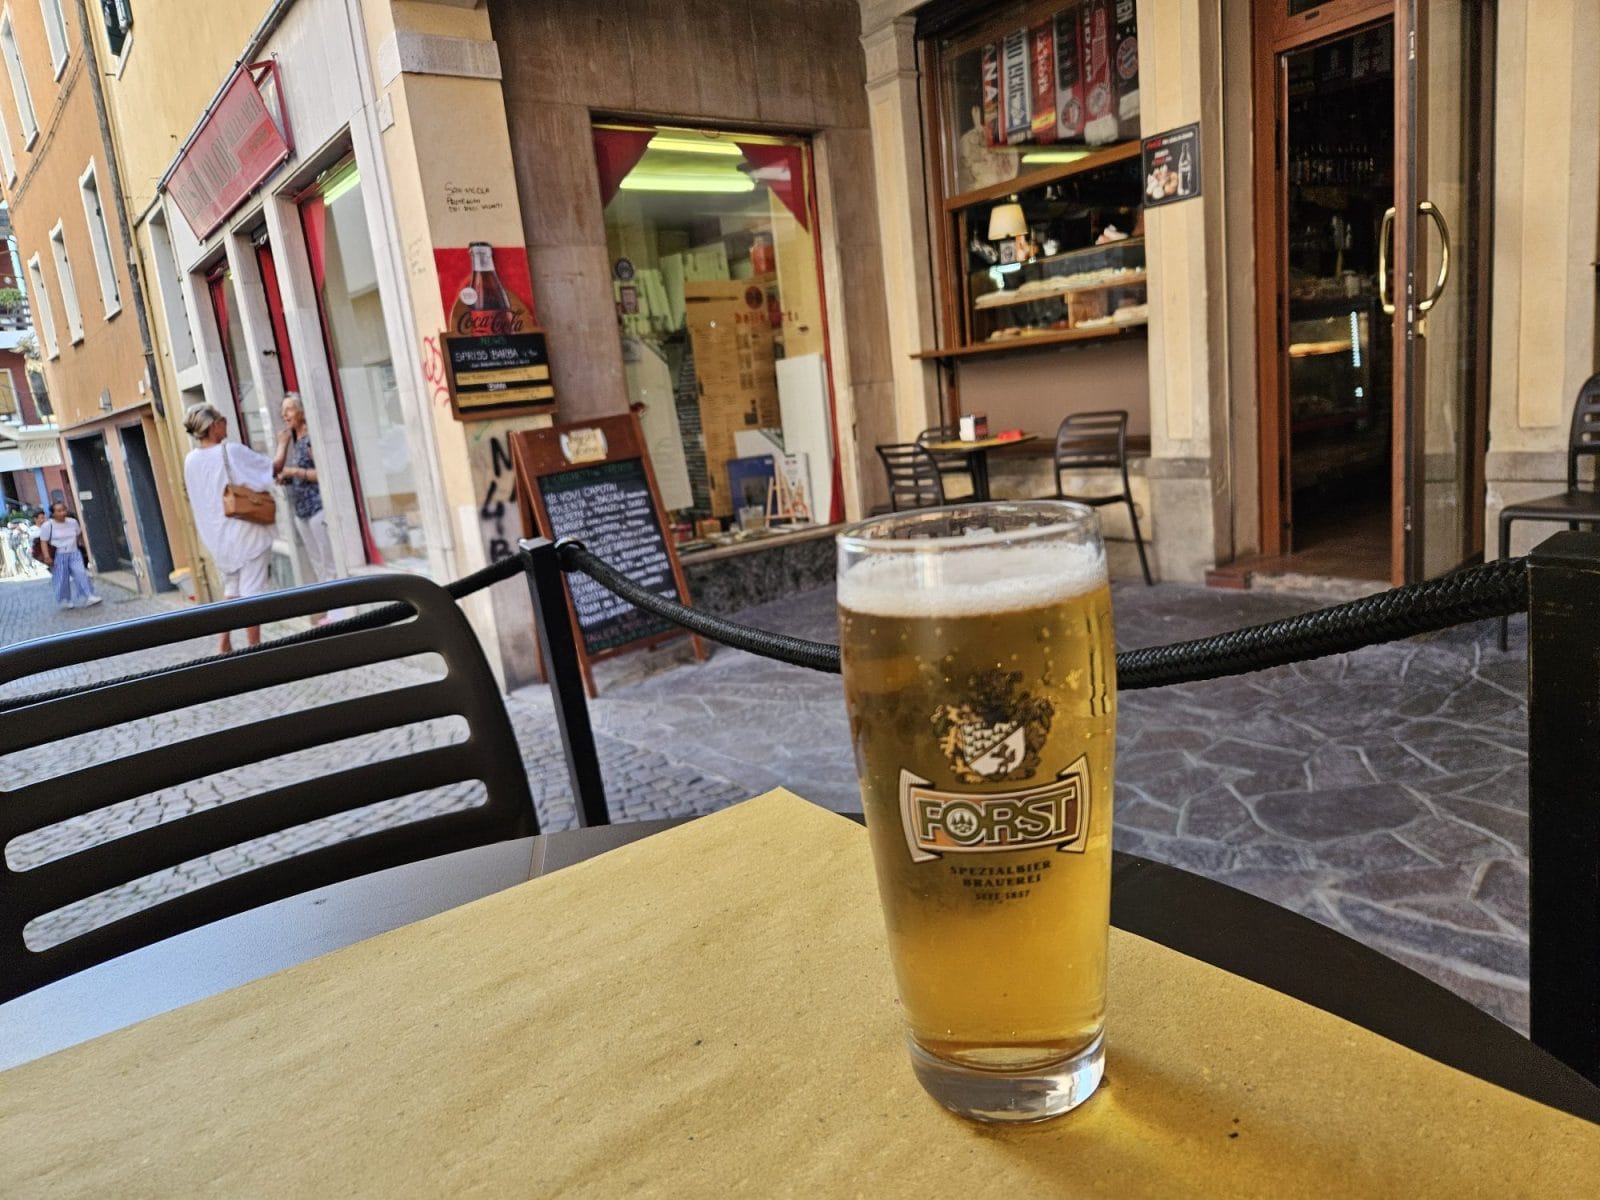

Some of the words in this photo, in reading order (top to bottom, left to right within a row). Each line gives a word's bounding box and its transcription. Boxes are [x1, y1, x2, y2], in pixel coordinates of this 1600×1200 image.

[916, 787, 1076, 845] FORST
[950, 860, 1051, 876] SPEZIALBIER
[962, 873, 1042, 888] BRAUEREI
